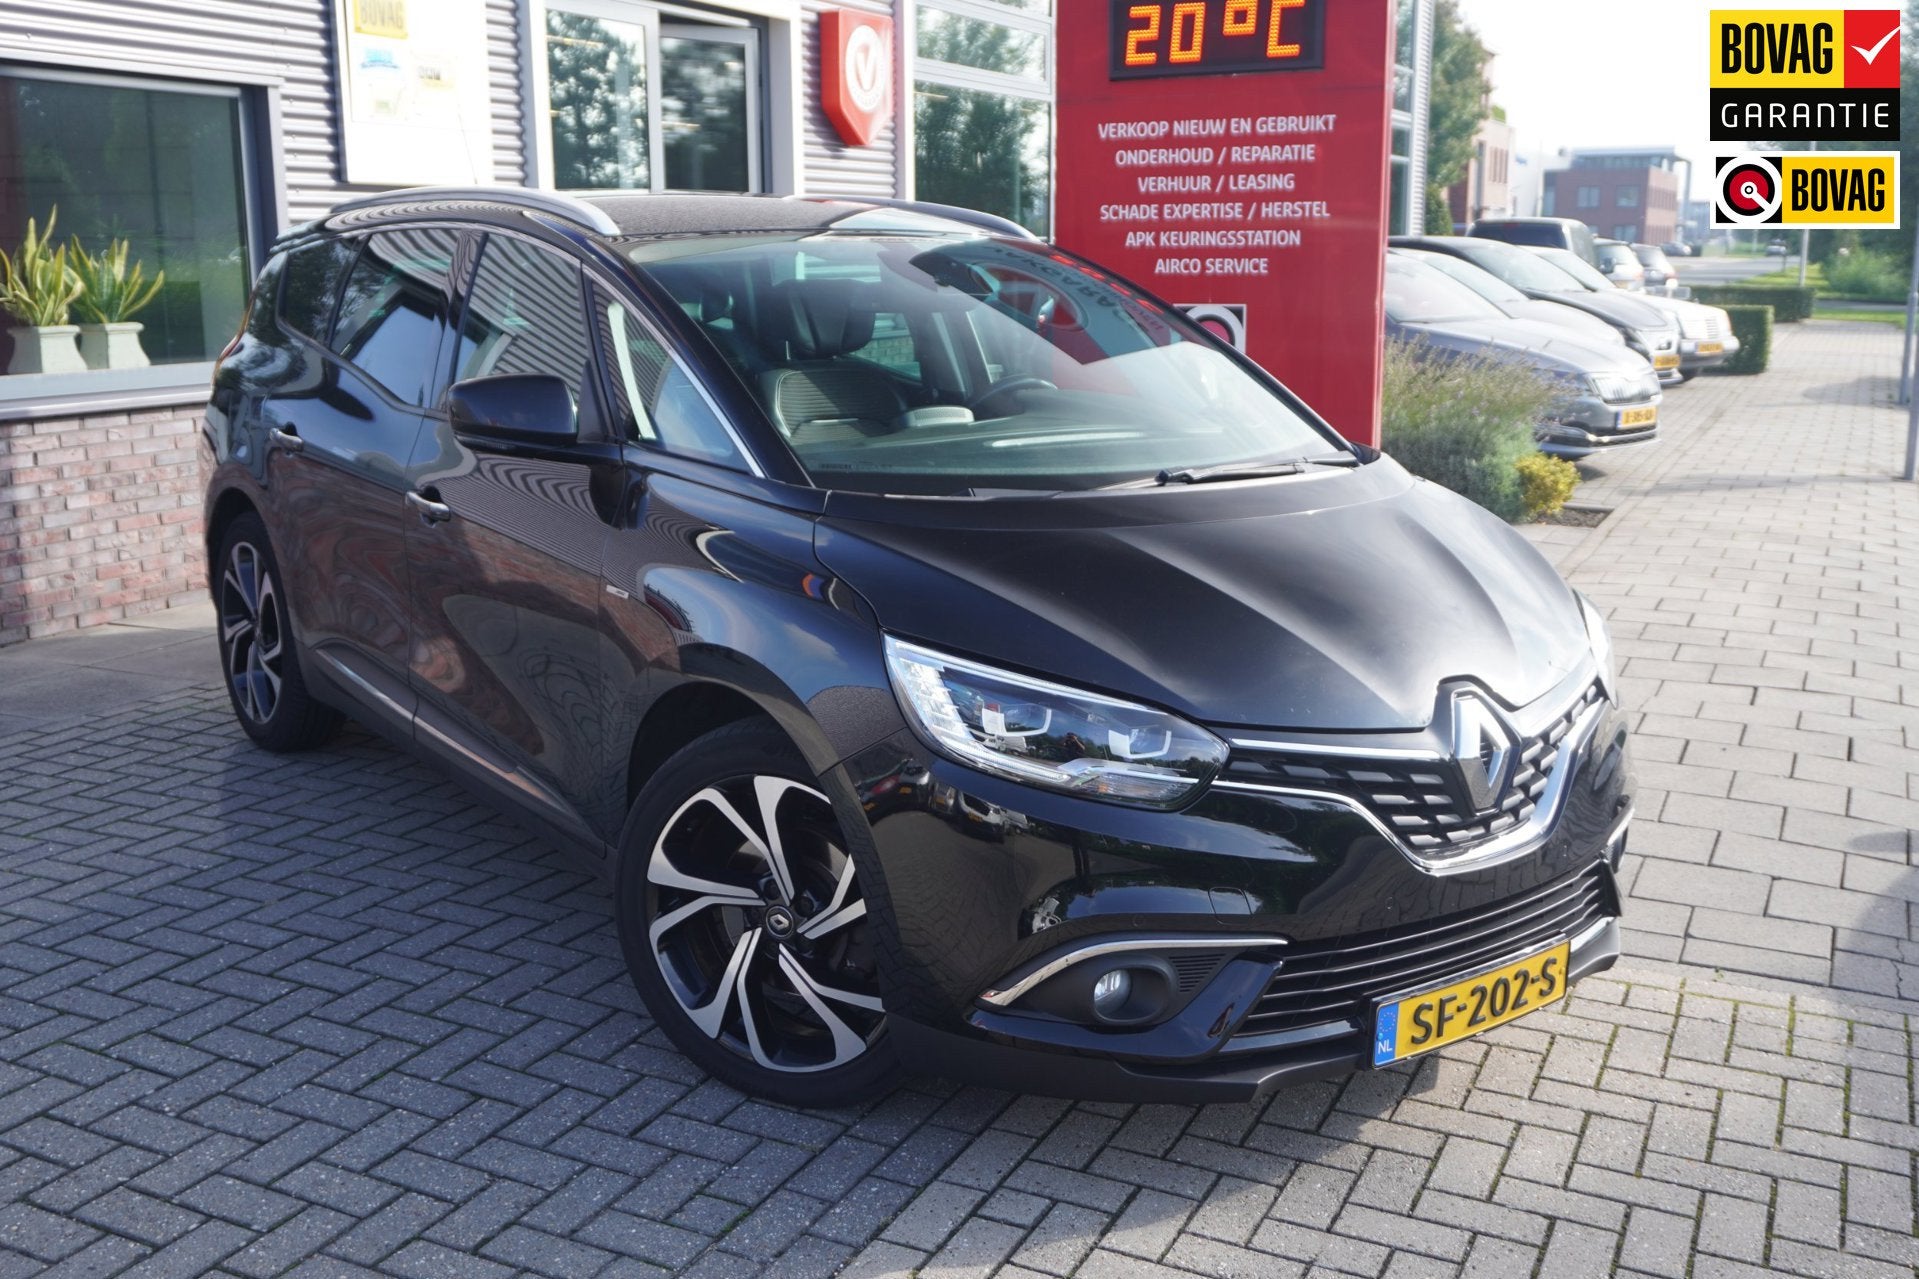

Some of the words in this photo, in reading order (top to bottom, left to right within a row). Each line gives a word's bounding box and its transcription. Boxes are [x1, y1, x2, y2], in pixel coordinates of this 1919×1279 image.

[1097, 120, 1170, 140] VERKOOP
[1172, 118, 1227, 137] NIEUW
[1230, 117, 1252, 135] EN
[1255, 113, 1337, 135] GEBRUIKT
[1115, 147, 1214, 166] ONDERHOUD
[1217, 146, 1227, 165] /
[1230, 143, 1316, 163] REPARATIE
[1137, 175, 1212, 193] VERHUUR
[1215, 174, 1225, 193] /
[1228, 172, 1295, 192] LEASING
[1099, 203, 1159, 221] SCHADE
[1162, 202, 1244, 220] EXPERTISE
[1247, 202, 1257, 221] /
[1260, 200, 1331, 220] HERSTEL
[1125, 230, 1156, 248] APK
[1159, 229, 1301, 248] KEURINGSSTATION
[1154, 257, 1202, 275] AIRCO
[1205, 257, 1269, 276] SERVICE
[1410, 956, 1558, 1046] SF-202-S
[1377, 1038, 1394, 1055] NL
